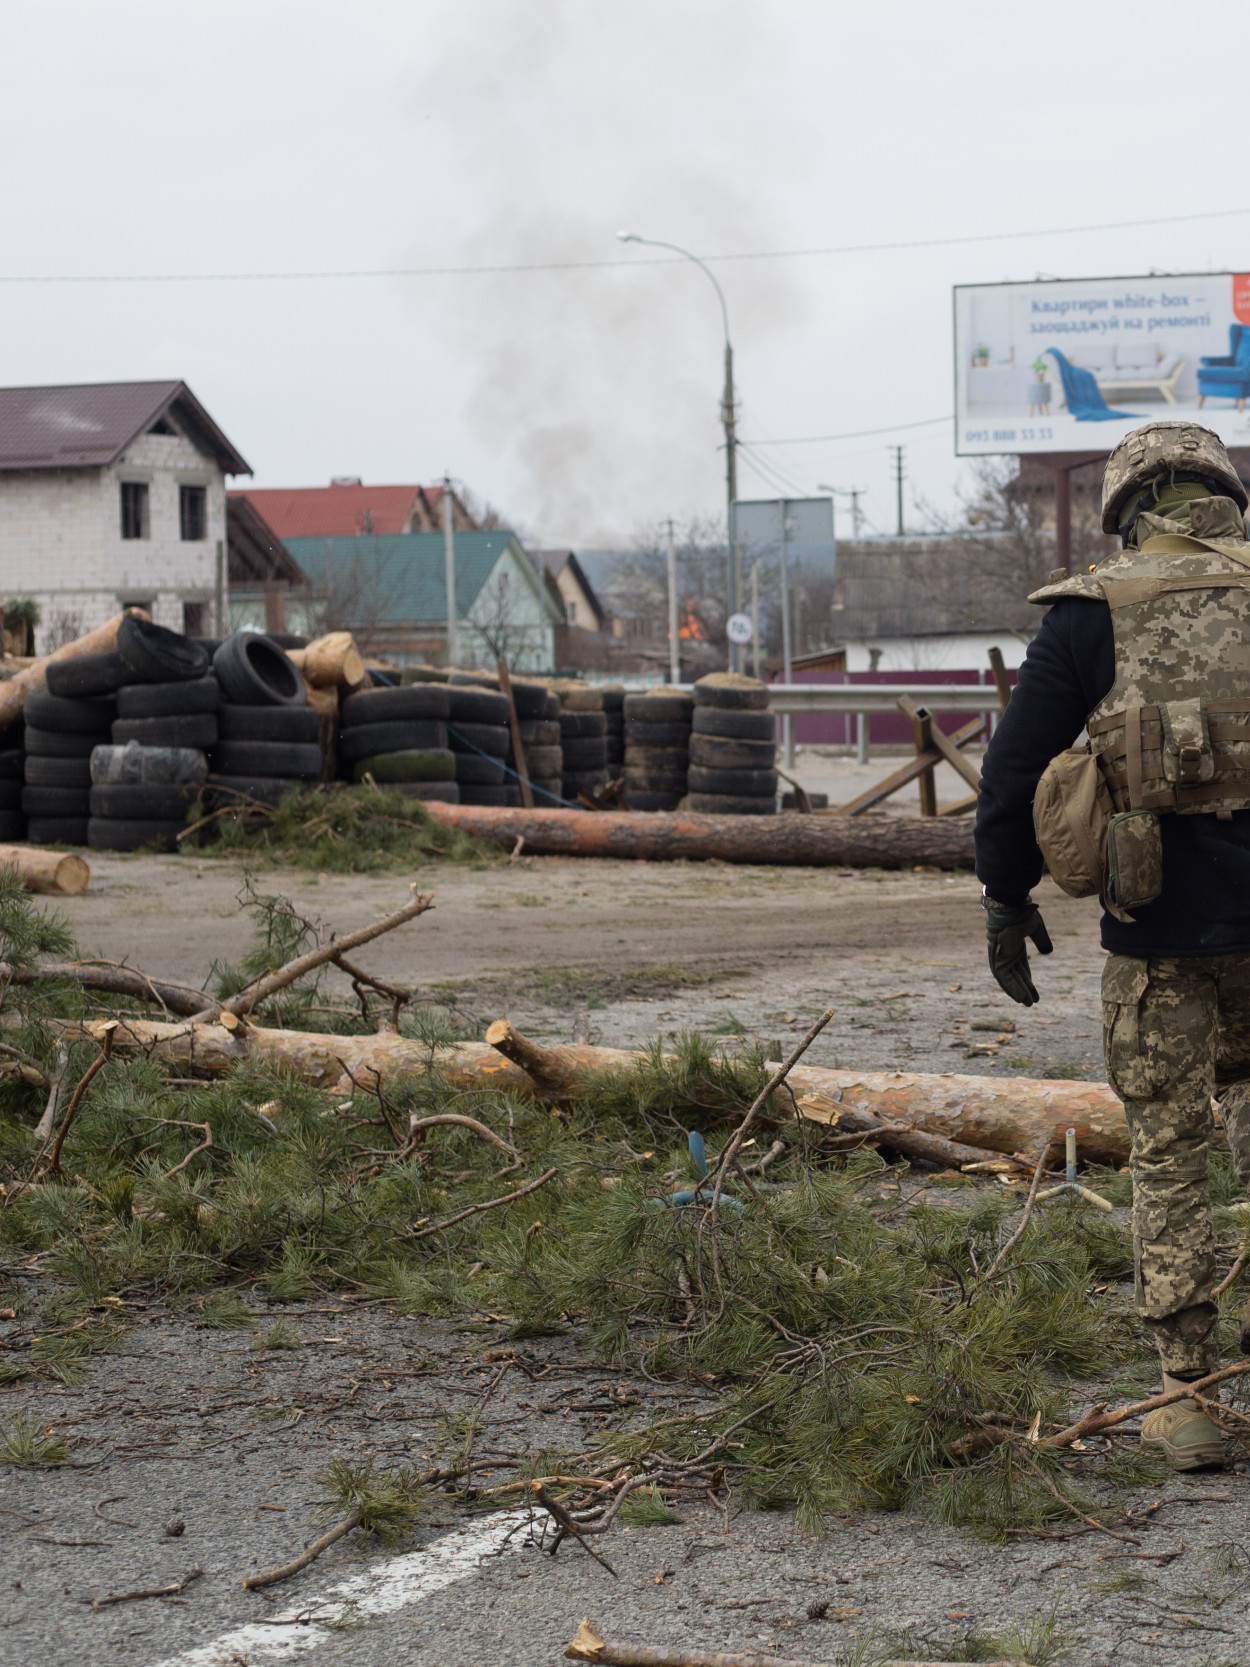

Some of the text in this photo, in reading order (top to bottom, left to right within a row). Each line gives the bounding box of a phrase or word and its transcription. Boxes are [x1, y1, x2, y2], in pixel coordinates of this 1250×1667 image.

[1031, 299, 1108, 316] Квартири
[1113, 291, 1190, 309] white-box
[1030, 311, 1211, 335] заощаджуй на ремонті
